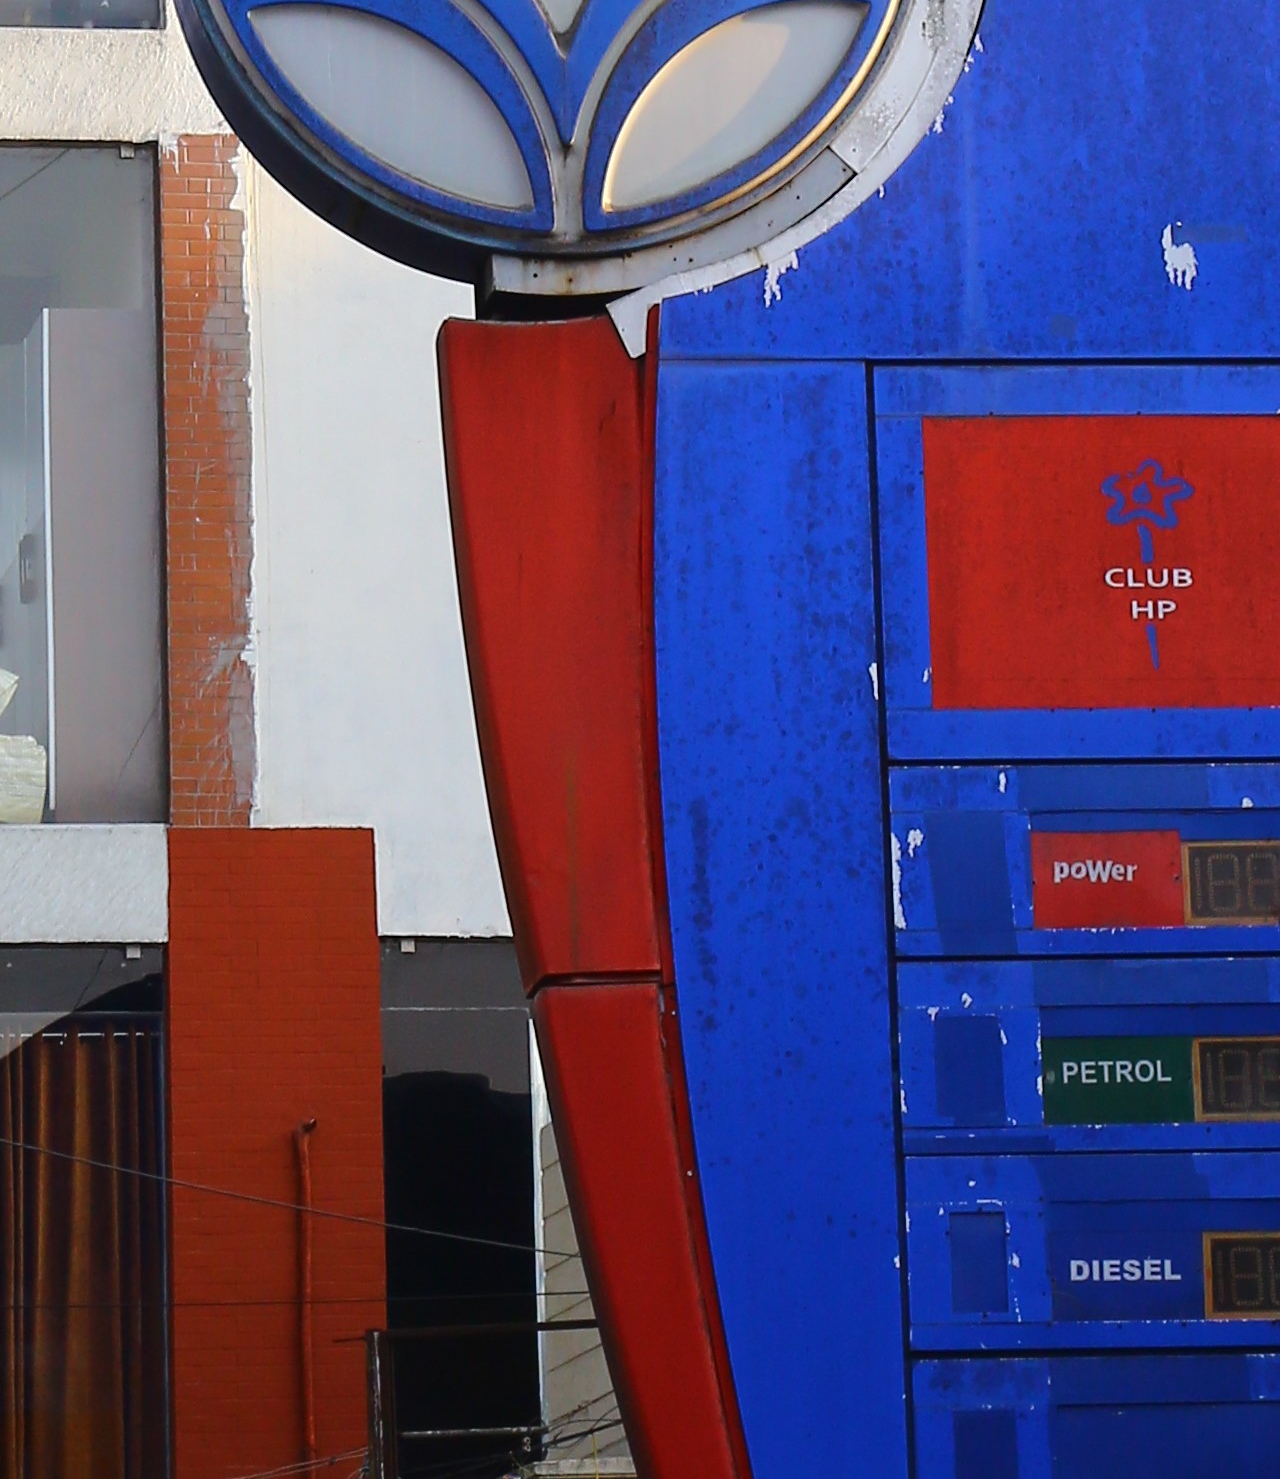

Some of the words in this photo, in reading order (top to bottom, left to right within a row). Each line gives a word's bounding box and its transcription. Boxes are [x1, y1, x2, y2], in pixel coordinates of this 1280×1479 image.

[1103, 567, 1195, 589] CLUB
[1130, 599, 1178, 620] HP
[1061, 1059, 1172, 1084] PETROL
[1069, 1258, 1182, 1282] DIESEL
